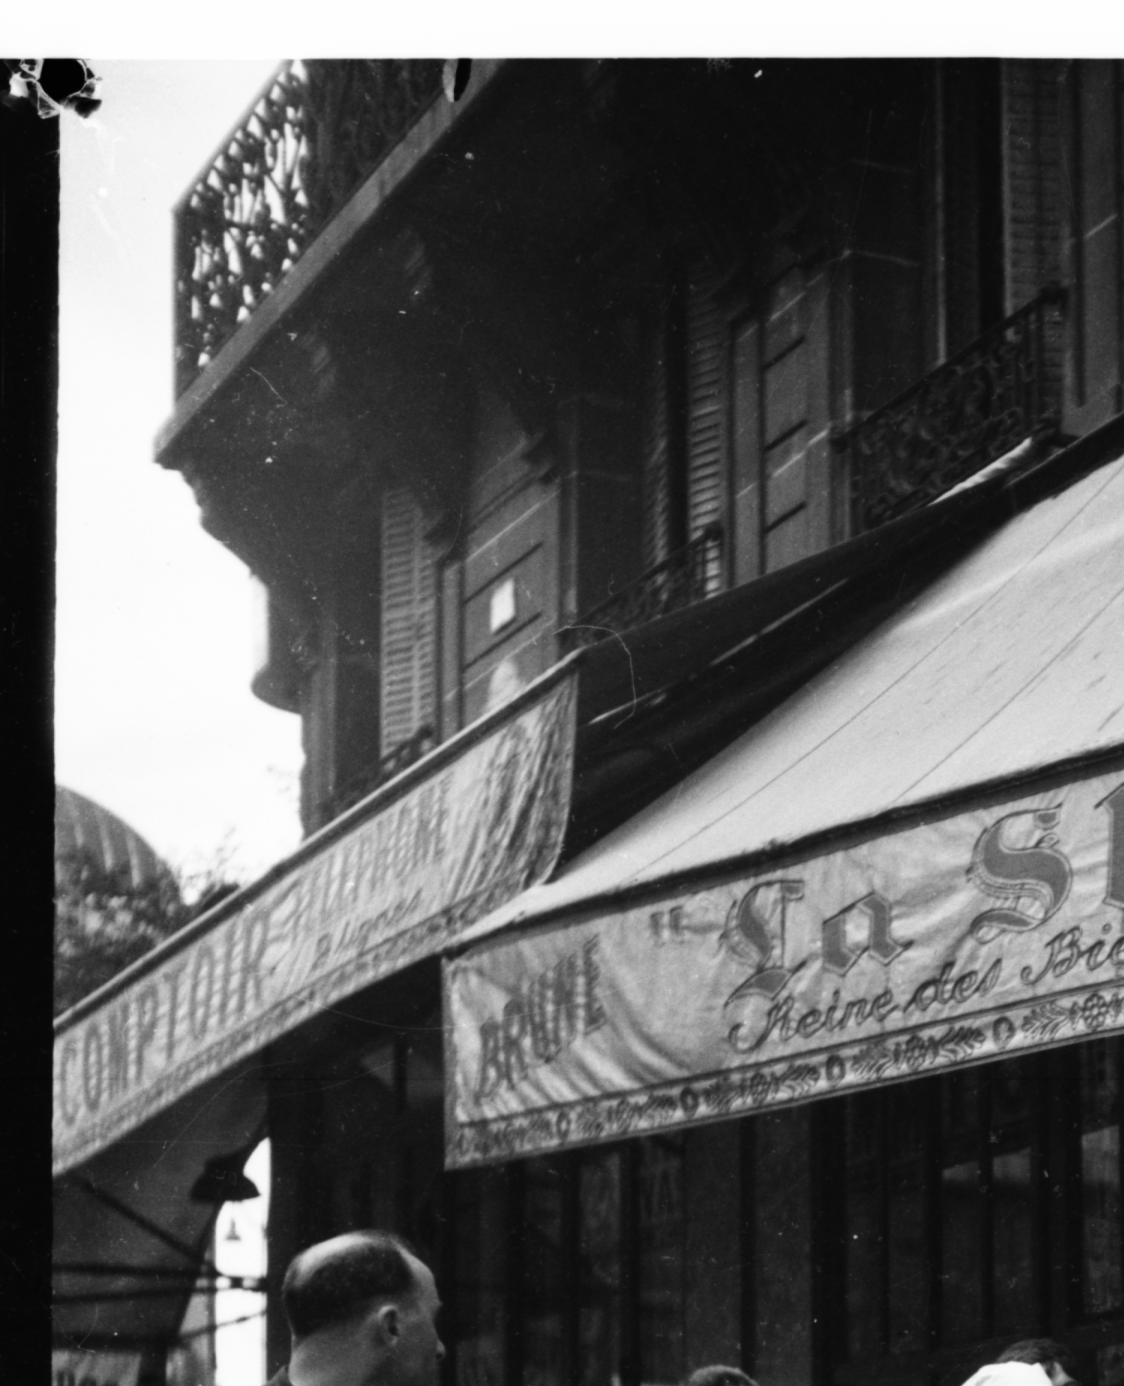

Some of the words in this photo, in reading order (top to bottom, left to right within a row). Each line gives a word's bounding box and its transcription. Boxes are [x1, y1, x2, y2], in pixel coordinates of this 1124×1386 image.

[59, 905, 272, 1126] COMPTOIR
[473, 932, 607, 1105] BRUNE
[727, 988, 898, 1051] Reine
[902, 959, 1002, 1012] des
